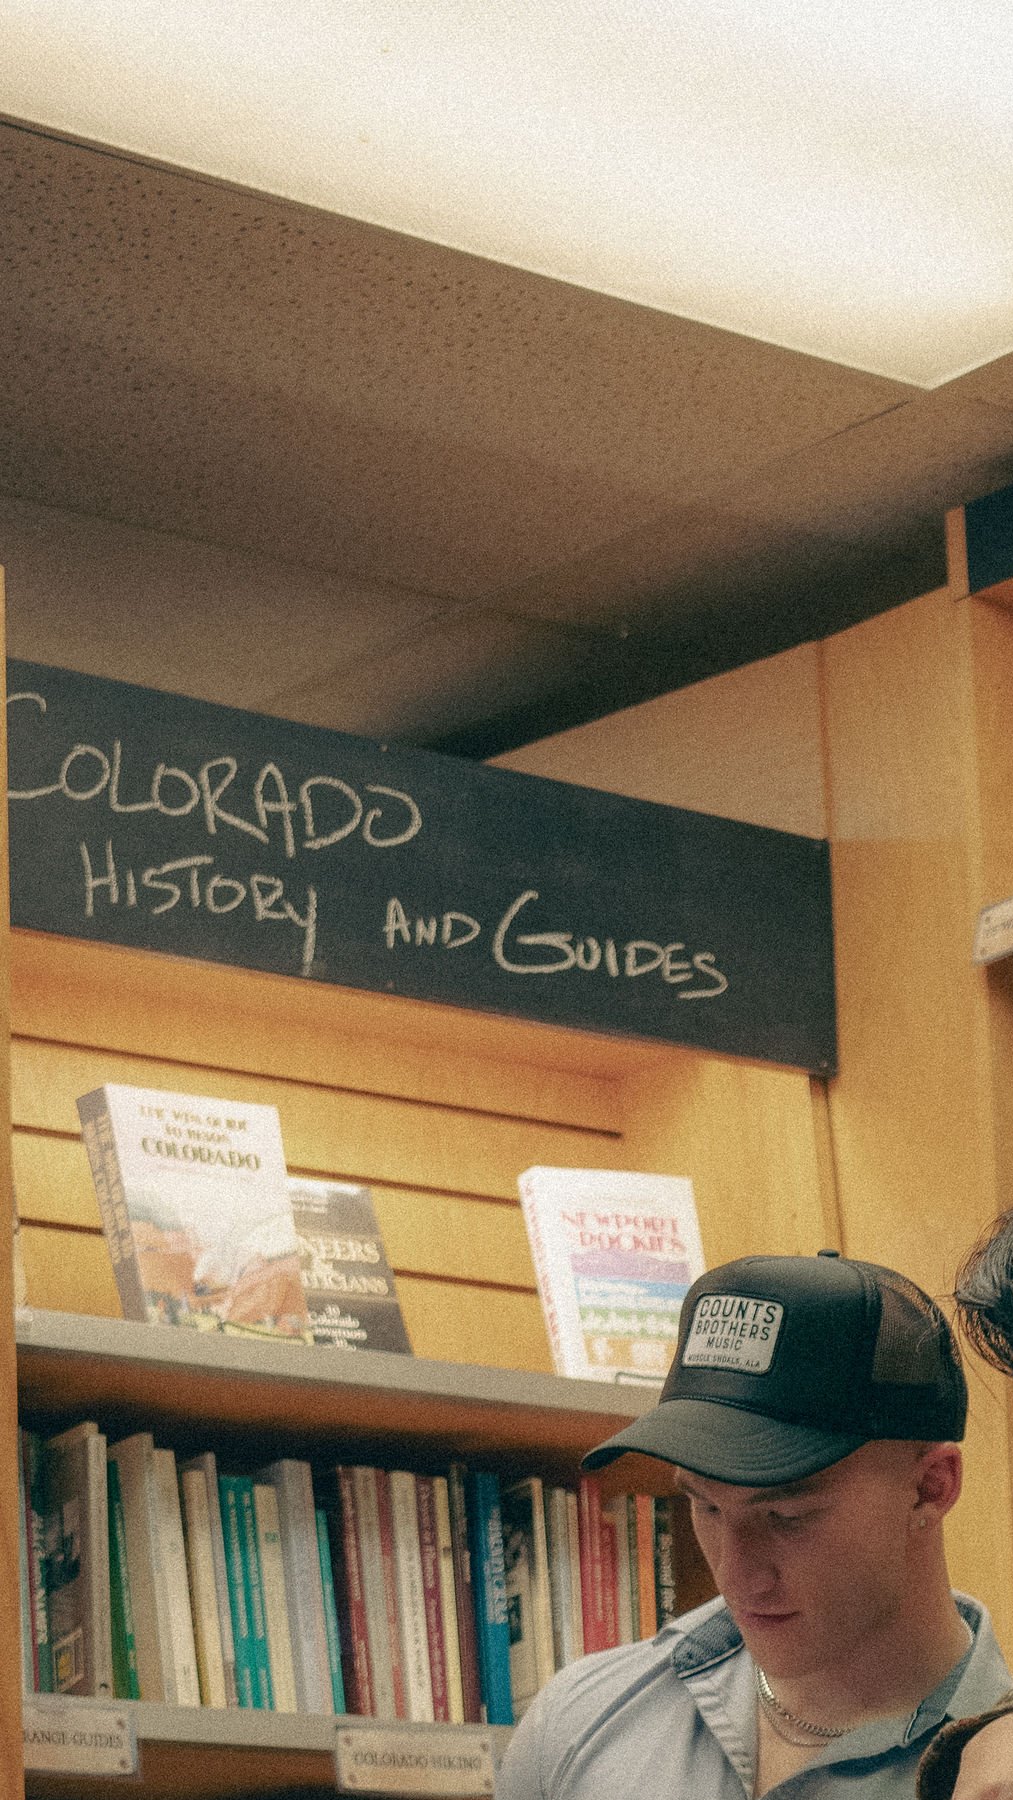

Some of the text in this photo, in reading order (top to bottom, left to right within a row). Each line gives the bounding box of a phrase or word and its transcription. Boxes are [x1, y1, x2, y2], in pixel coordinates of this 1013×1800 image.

[6, 691, 422, 857] COLORADO
[81, 839, 729, 999] HISTORY AND GUIDES
[141, 1137, 261, 1171] COLORADO
[560, 1210, 679, 1233] NEWPORT
[699, 1299, 777, 1324] COUNTS
[695, 1319, 771, 1341] BROTHERS
[706, 1337, 743, 1350] MUSIC
[70, 1732, 123, 1748] GUIDES
[354, 1751, 482, 1769] COLORADO HIKING
